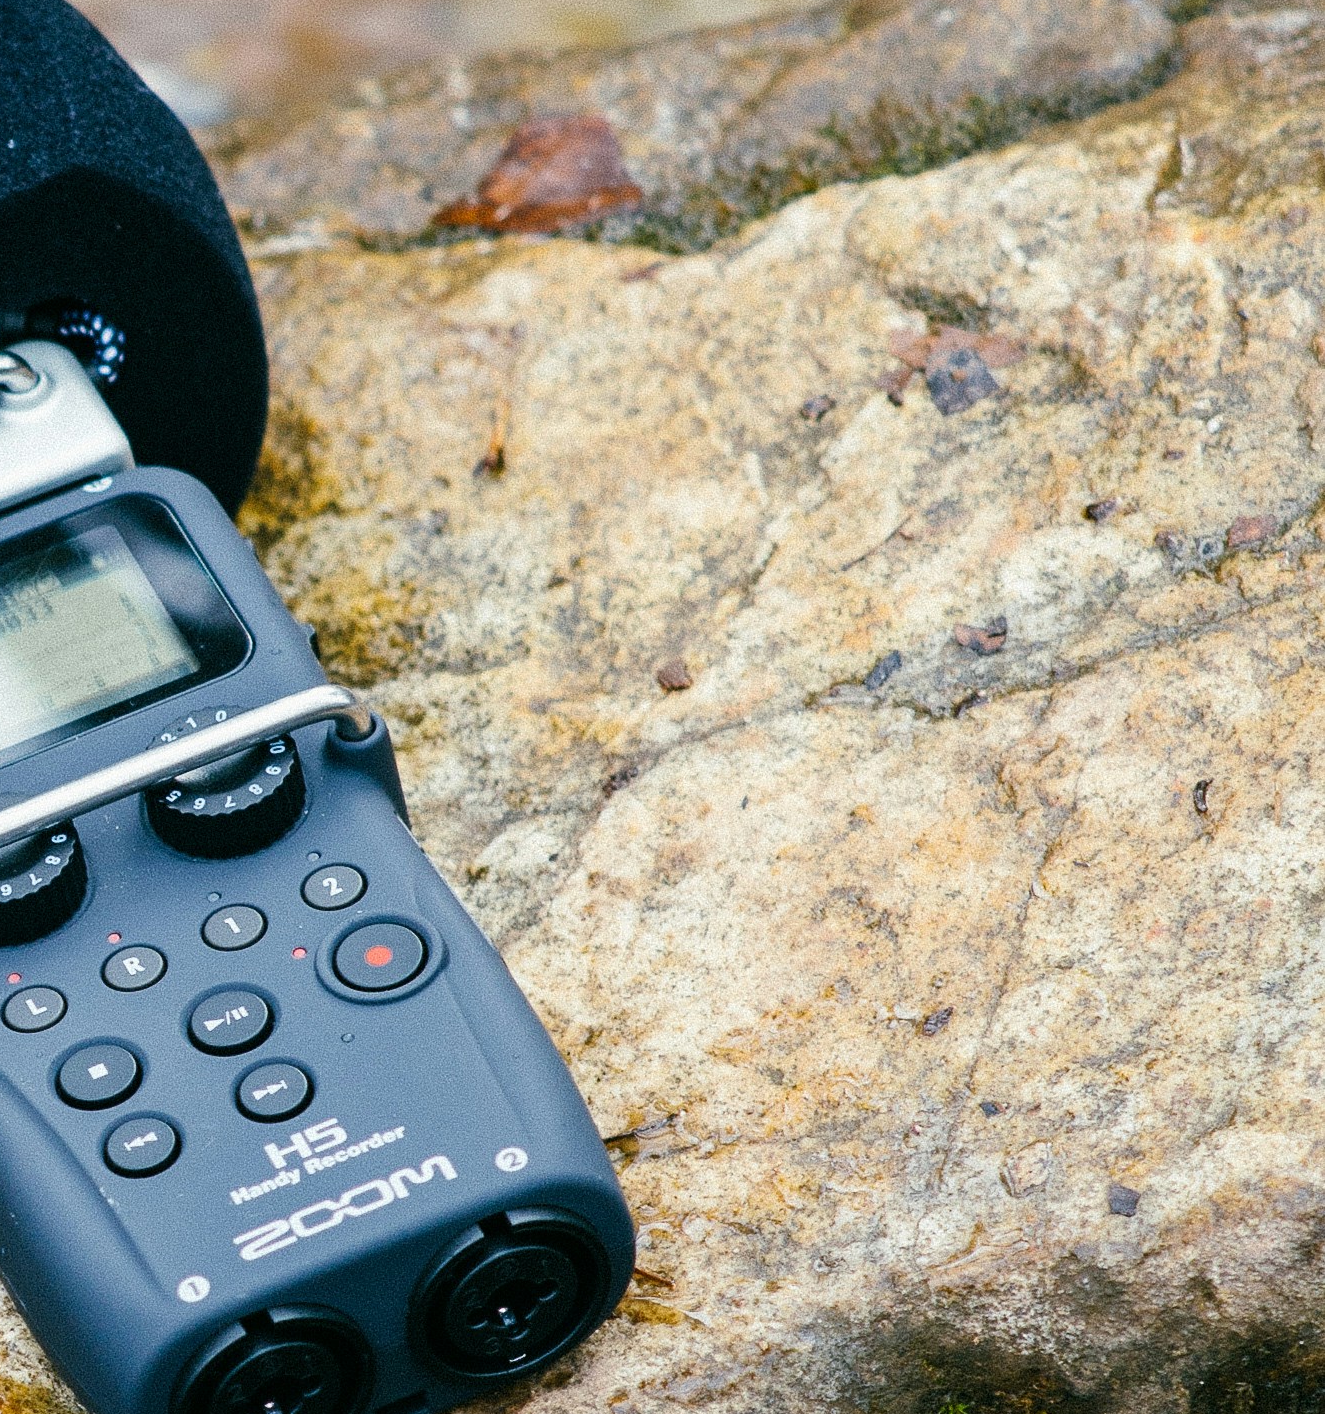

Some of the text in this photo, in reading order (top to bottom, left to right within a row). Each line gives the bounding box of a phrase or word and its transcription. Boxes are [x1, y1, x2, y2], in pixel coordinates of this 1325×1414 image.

[160, 709, 228, 743] 2 1 0
[269, 739, 286, 755] 10
[265, 764, 282, 776] 9
[248, 783, 264, 796] 8
[192, 797, 206, 810] 6
[224, 795, 237, 809] 7
[51, 833, 68, 844] 9
[44, 855, 61, 866] 8
[29, 873, 43, 886] 7
[0, 883, 13, 897] 6
[25, 876, 344, 1016] L R 1 2
[263, 1117, 348, 1169] H5
[229, 1125, 407, 1206] Handy Recorder
[232, 1154, 459, 1262] ZOOM
